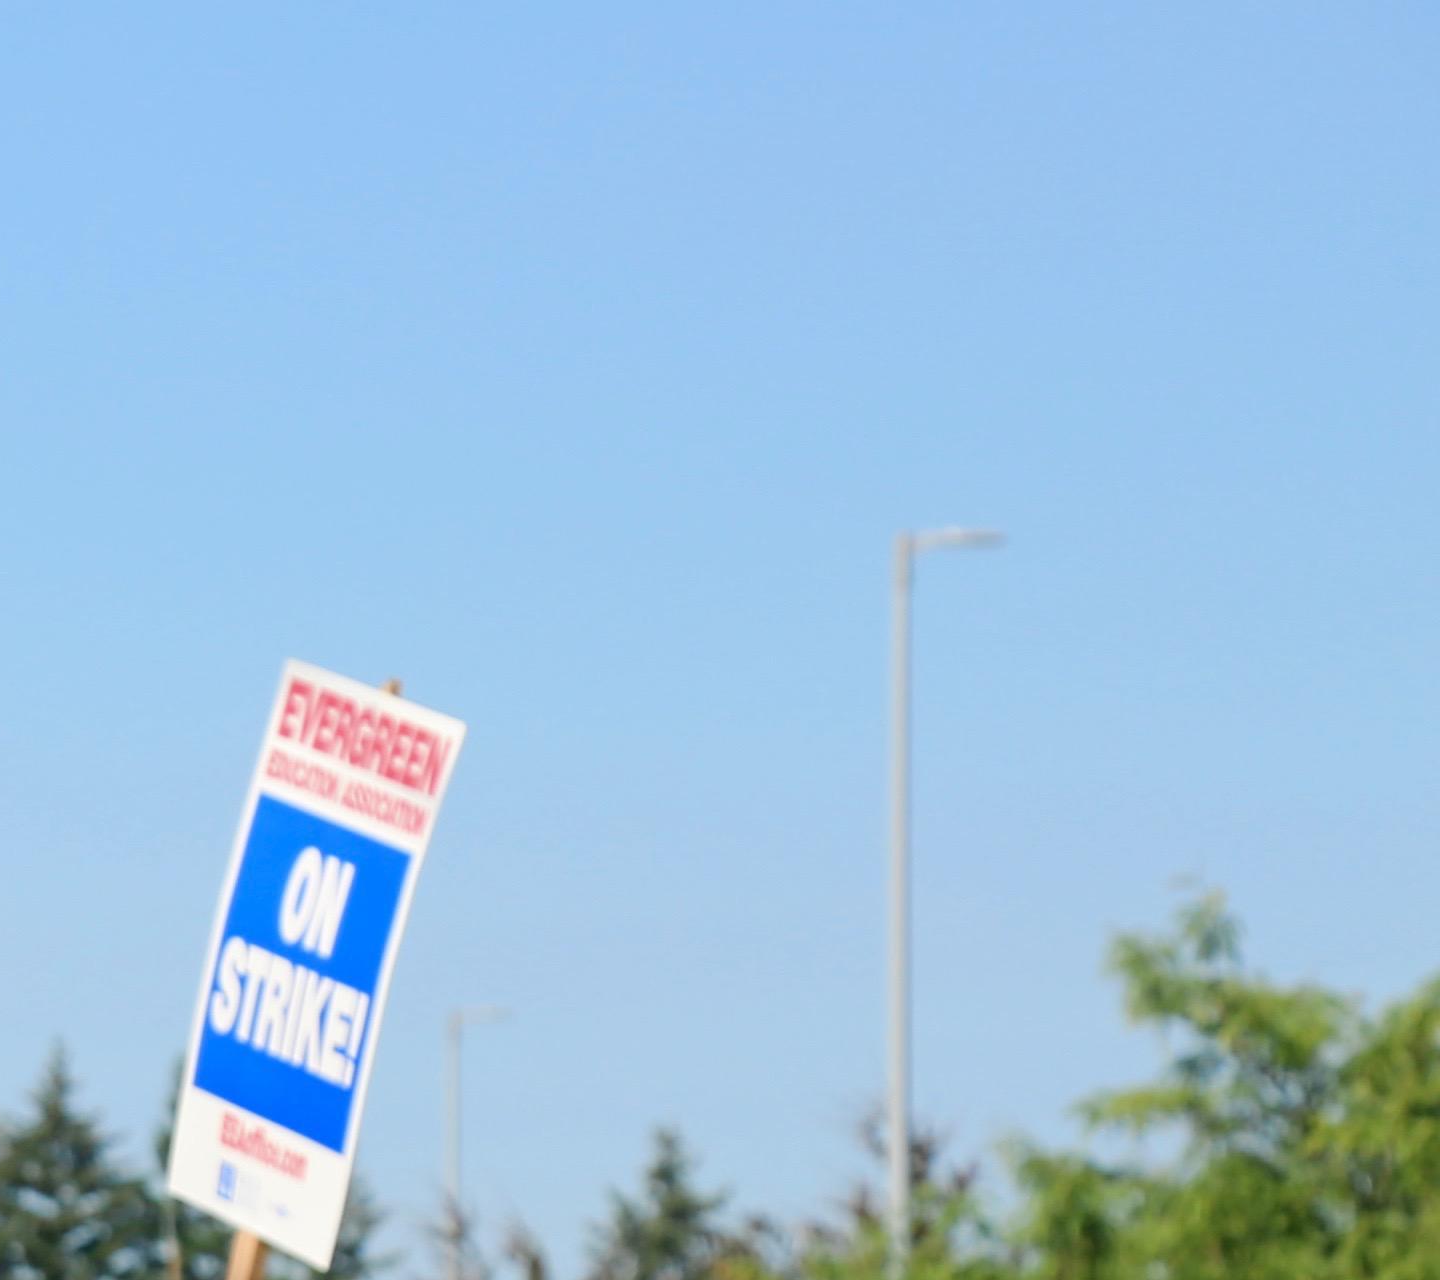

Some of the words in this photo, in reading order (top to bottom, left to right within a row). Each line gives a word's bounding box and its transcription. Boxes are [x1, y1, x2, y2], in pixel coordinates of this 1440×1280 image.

[279, 679, 452, 795] EVERGREEN
[280, 846, 356, 959] ON
[208, 935, 370, 1090] STRIKE!
